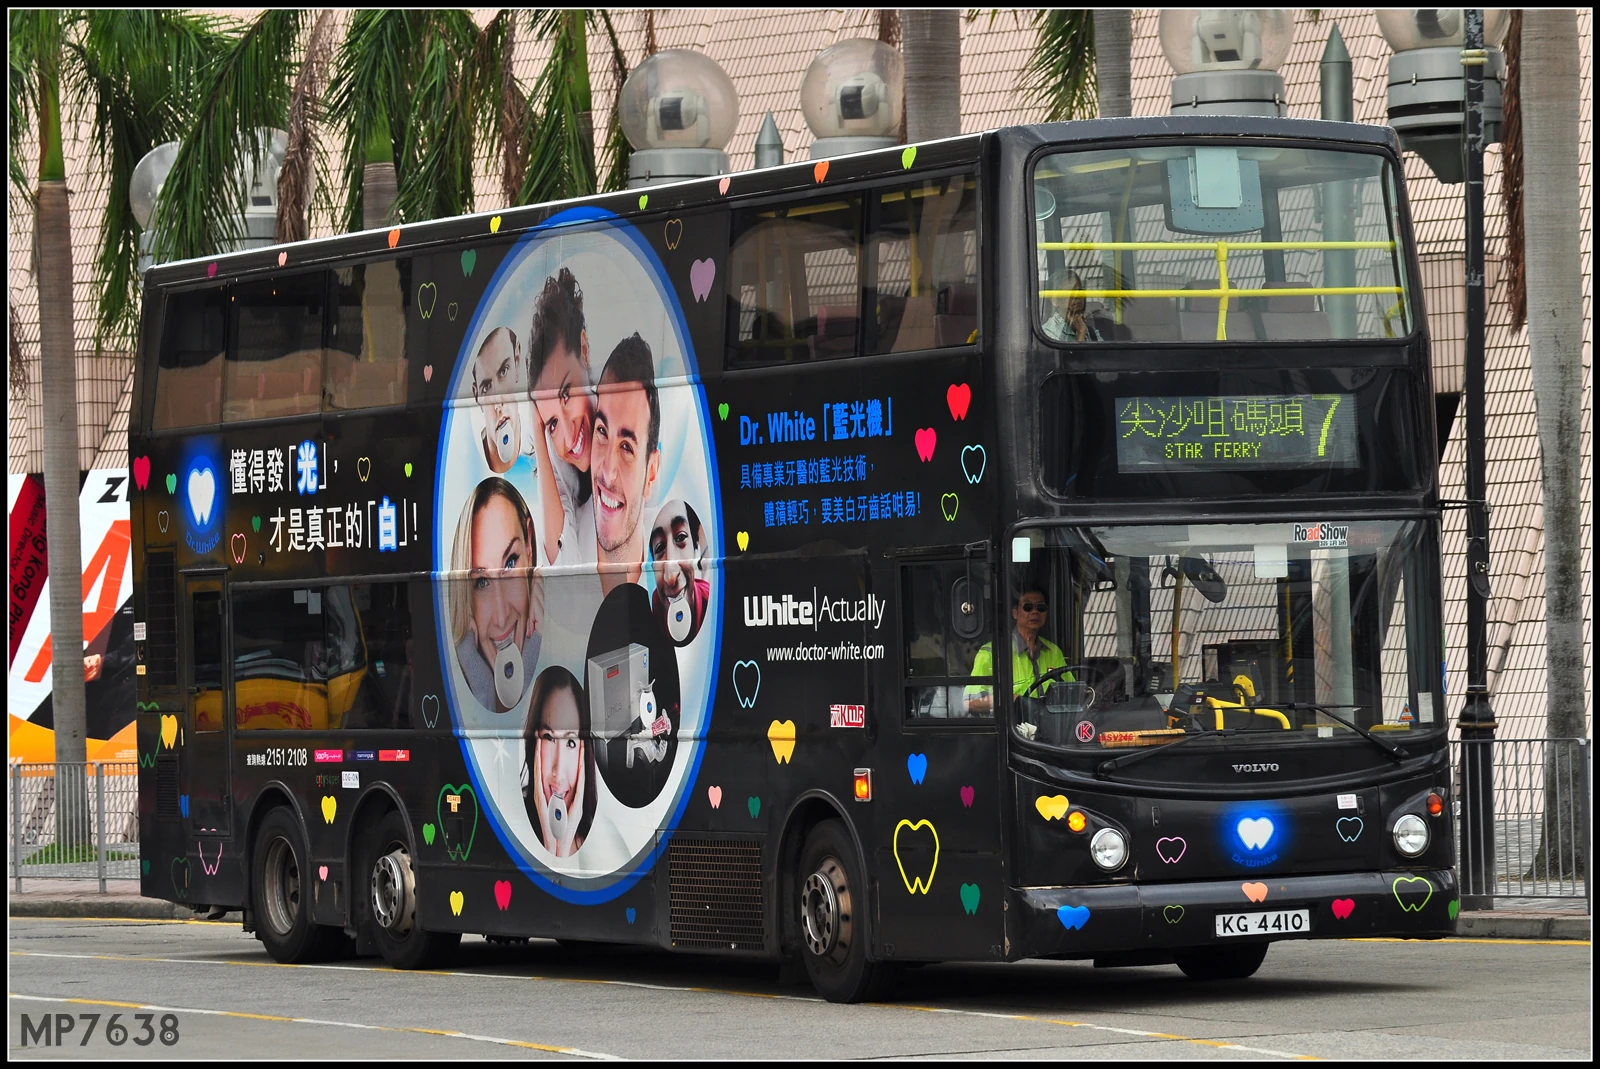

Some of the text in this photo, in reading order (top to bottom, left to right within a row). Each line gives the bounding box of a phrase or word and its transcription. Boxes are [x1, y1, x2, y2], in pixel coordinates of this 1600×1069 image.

[1120, 397, 1304, 437] 尖沙咀碼頭
[1312, 393, 1341, 456] 7
[739, 414, 764, 446] Dr.
[767, 410, 816, 444] White
[1165, 442, 1261, 458] STAR FERRY
[1294, 523, 1348, 541] RoadShow
[13, 553, 43, 602] Kong
[743, 593, 886, 629] White Actually
[766, 641, 885, 662] www.doctor-white.com
[267, 748, 285, 766] 2151
[287, 748, 308, 766] 2108
[1232, 762, 1280, 773] VOLVO
[1222, 913, 1303, 934] KG 4410
